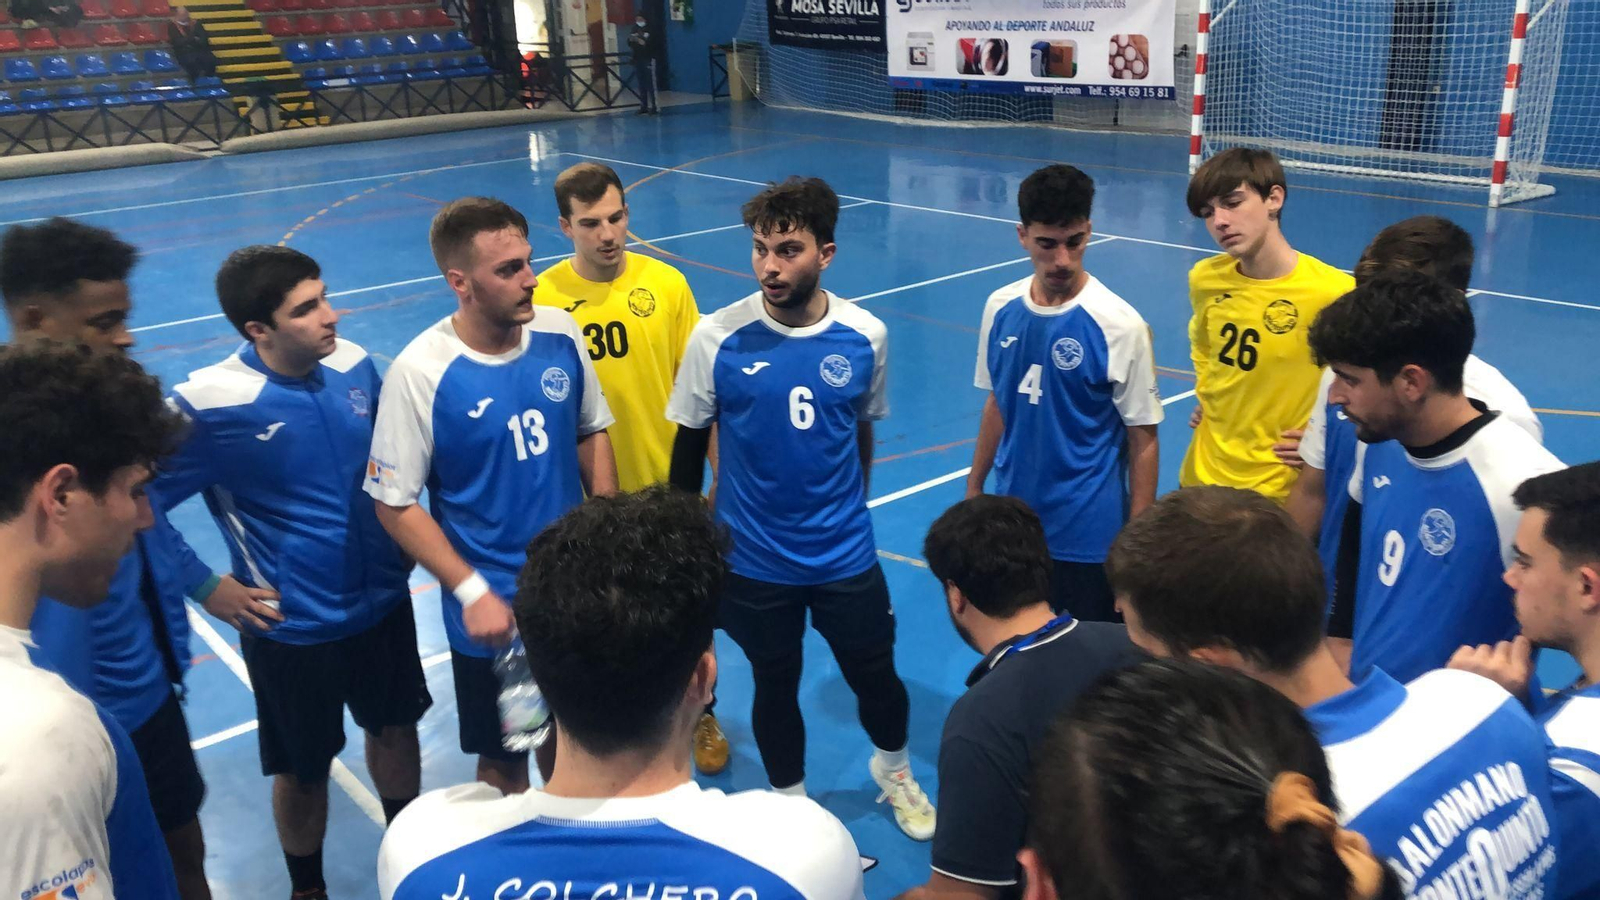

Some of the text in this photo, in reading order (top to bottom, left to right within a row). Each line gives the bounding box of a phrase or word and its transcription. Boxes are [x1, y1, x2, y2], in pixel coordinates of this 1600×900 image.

[791, 0, 880, 15] MOSA SEVILLA
[945, 20, 1095, 32] APOYANDO AL DEPORTE ANDALUZ
[1024, 85, 1082, 96] www.surjet.com
[1109, 86, 1126, 97] 954
[1128, 86, 1140, 97] 69
[1143, 87, 1155, 98] 15
[1157, 87, 1169, 98] 81
[583, 321, 629, 361] 30
[1218, 322, 1260, 372] 26
[1017, 363, 1043, 405] 4
[788, 386, 815, 431] 6
[507, 408, 549, 462] 13
[1377, 529, 1406, 587] 9
[1405, 792, 1550, 900] NTEQUINTO
[20, 857, 96, 900] escolaps
